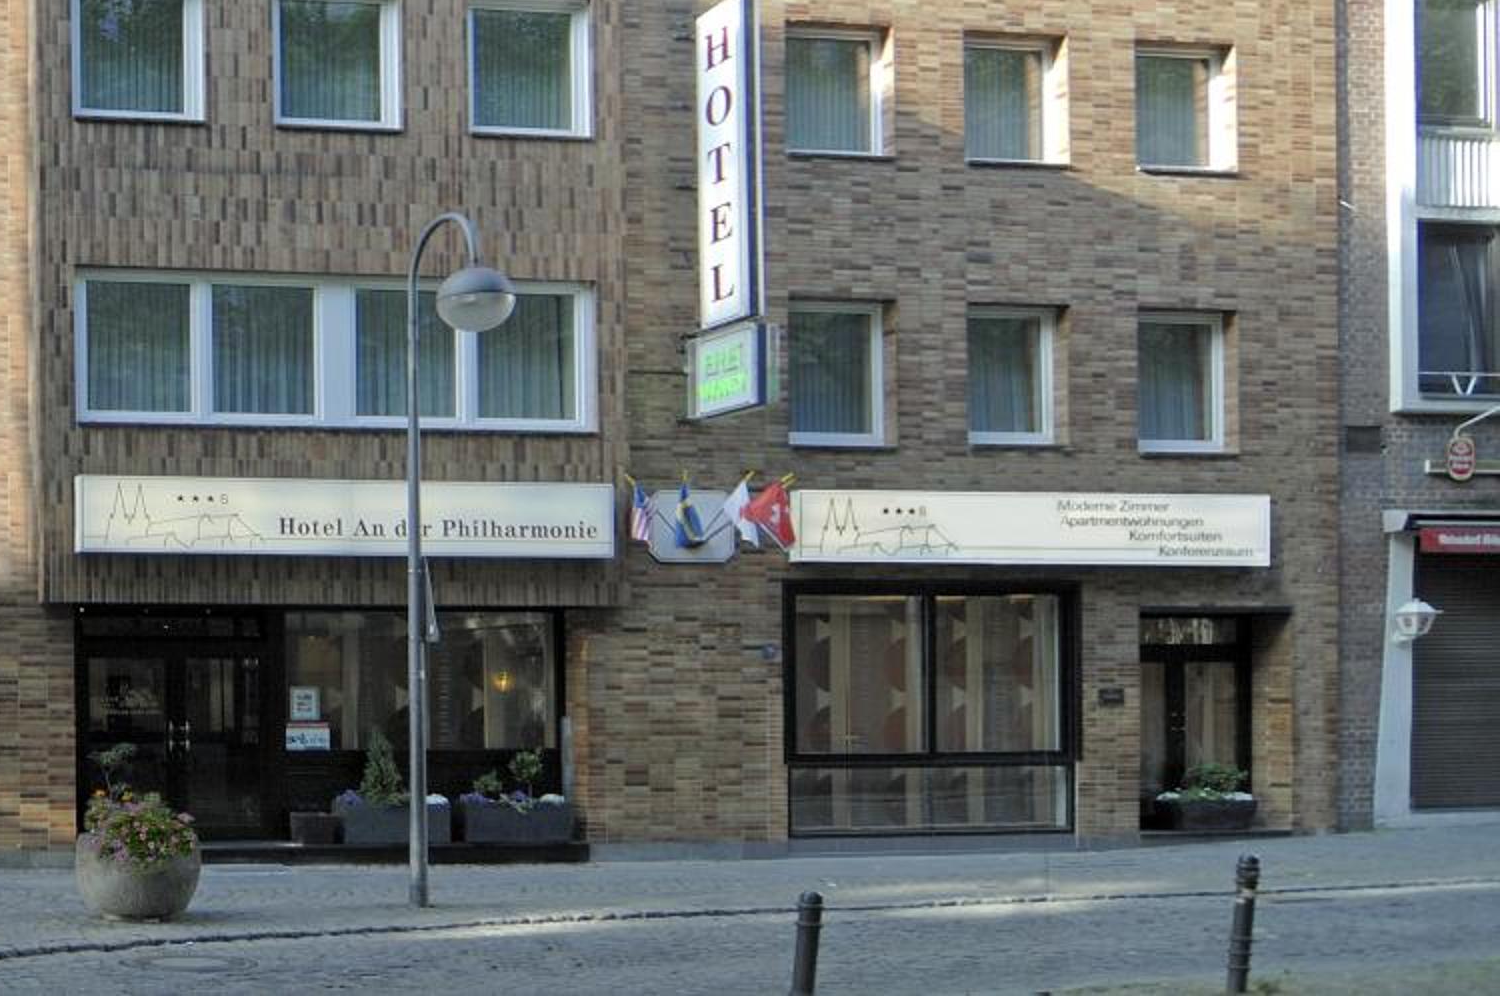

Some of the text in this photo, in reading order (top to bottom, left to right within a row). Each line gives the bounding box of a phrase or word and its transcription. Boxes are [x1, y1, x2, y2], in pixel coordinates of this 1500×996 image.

[703, 25, 735, 304] HOTEL
[1057, 500, 1171, 513] Moderne Zimmer
[279, 517, 598, 540] Hotel An dr Philharmonie
[1060, 515, 1205, 529] Apartmentwohnungen
[1128, 530, 1223, 542] Komfortsuiten
[1158, 545, 1254, 557] Konferenzraum
